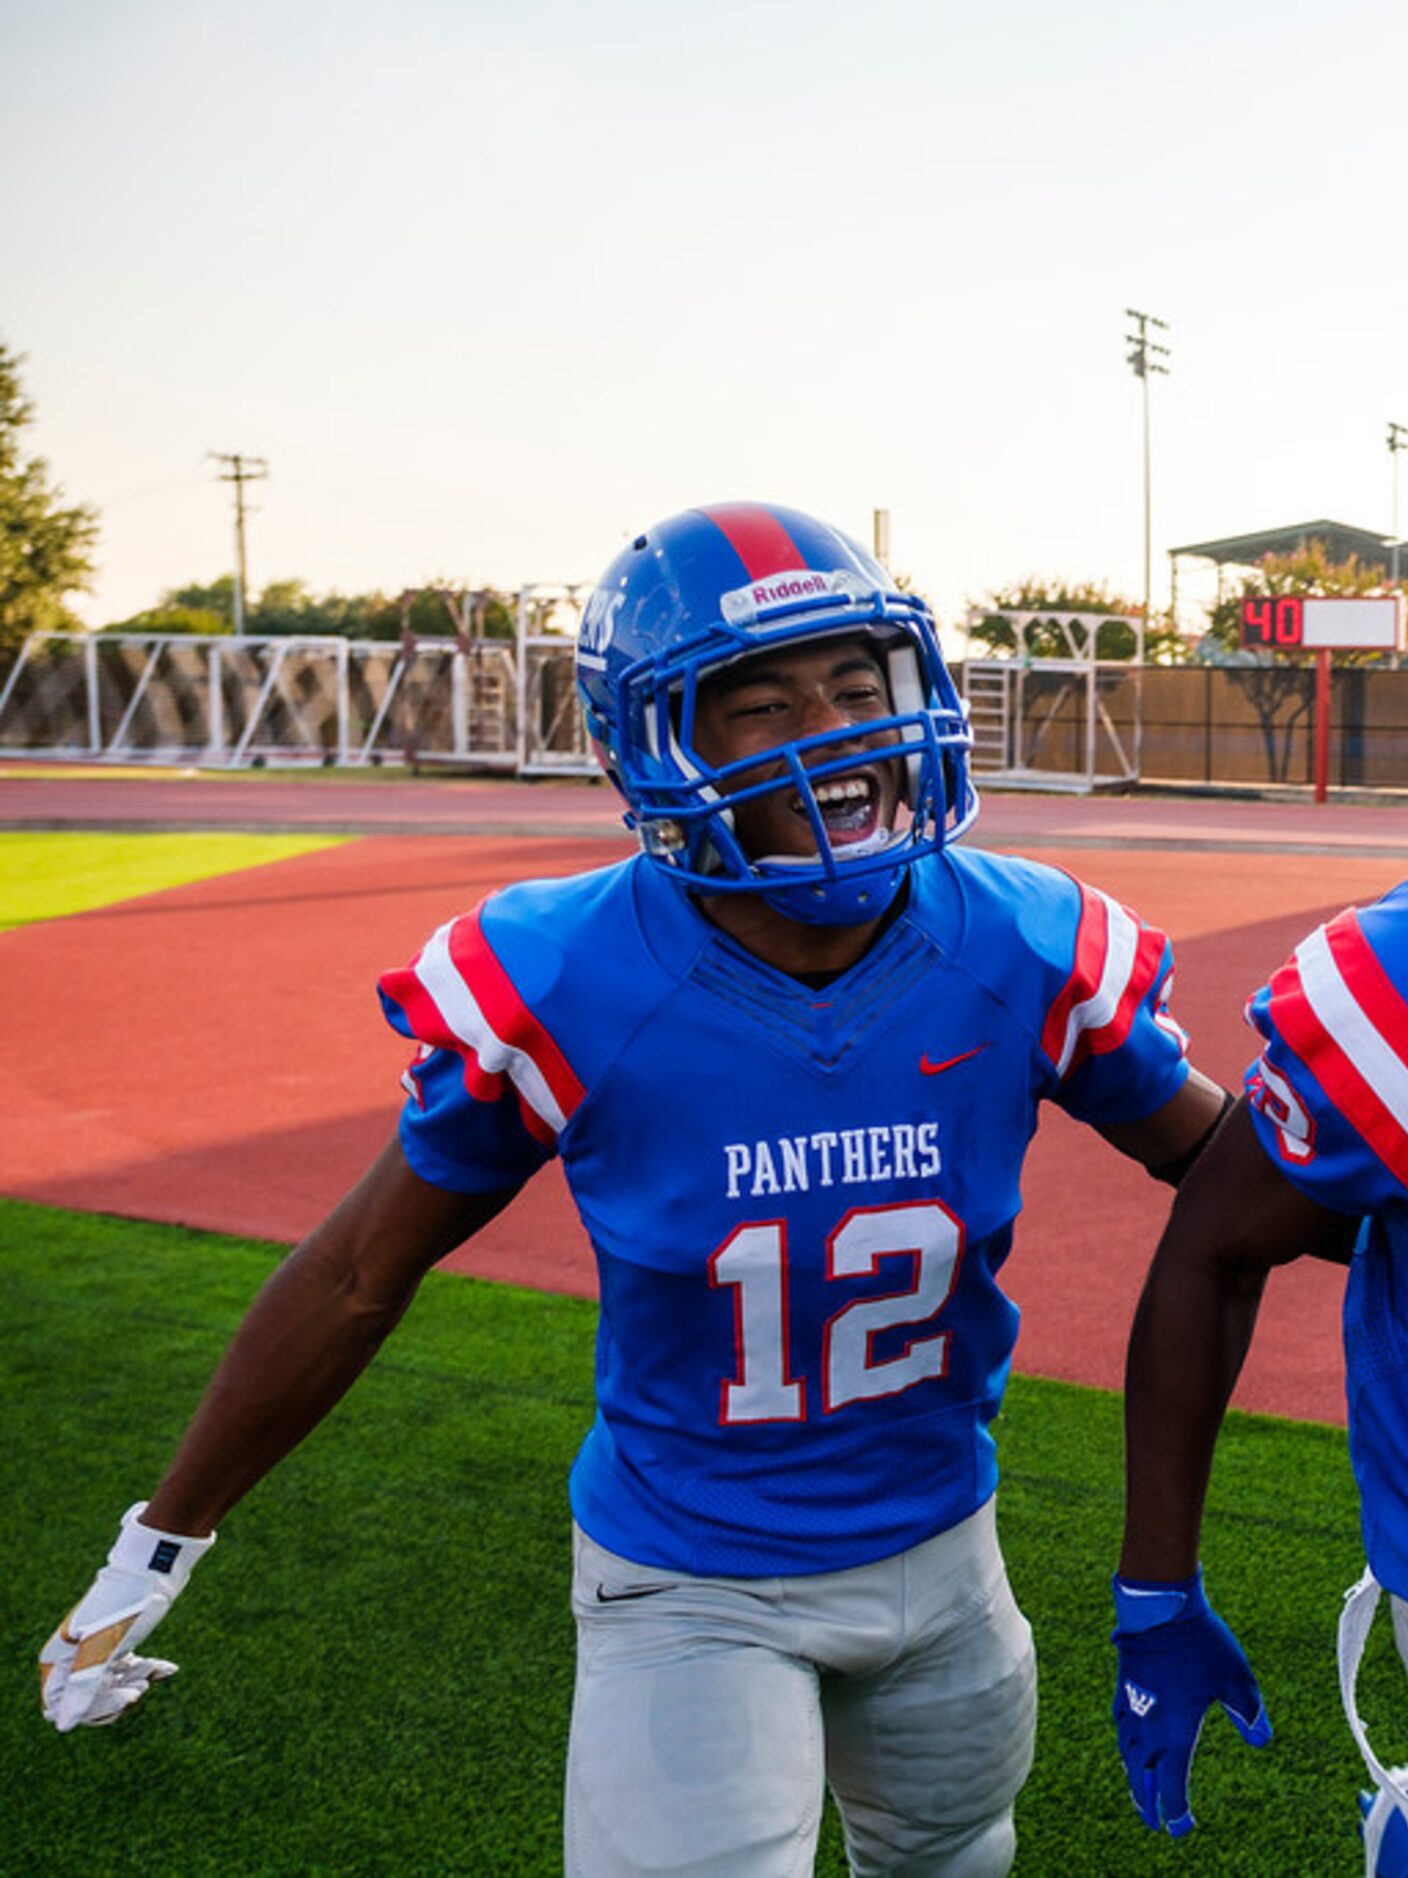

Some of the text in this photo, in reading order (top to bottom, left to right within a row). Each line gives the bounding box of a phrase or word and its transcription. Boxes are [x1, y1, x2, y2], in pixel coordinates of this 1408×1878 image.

[752, 575, 827, 605] Riddell
[1245, 598, 1301, 644] 40
[724, 1122, 942, 1198] PANTHERS
[707, 1198, 966, 1426] 12
